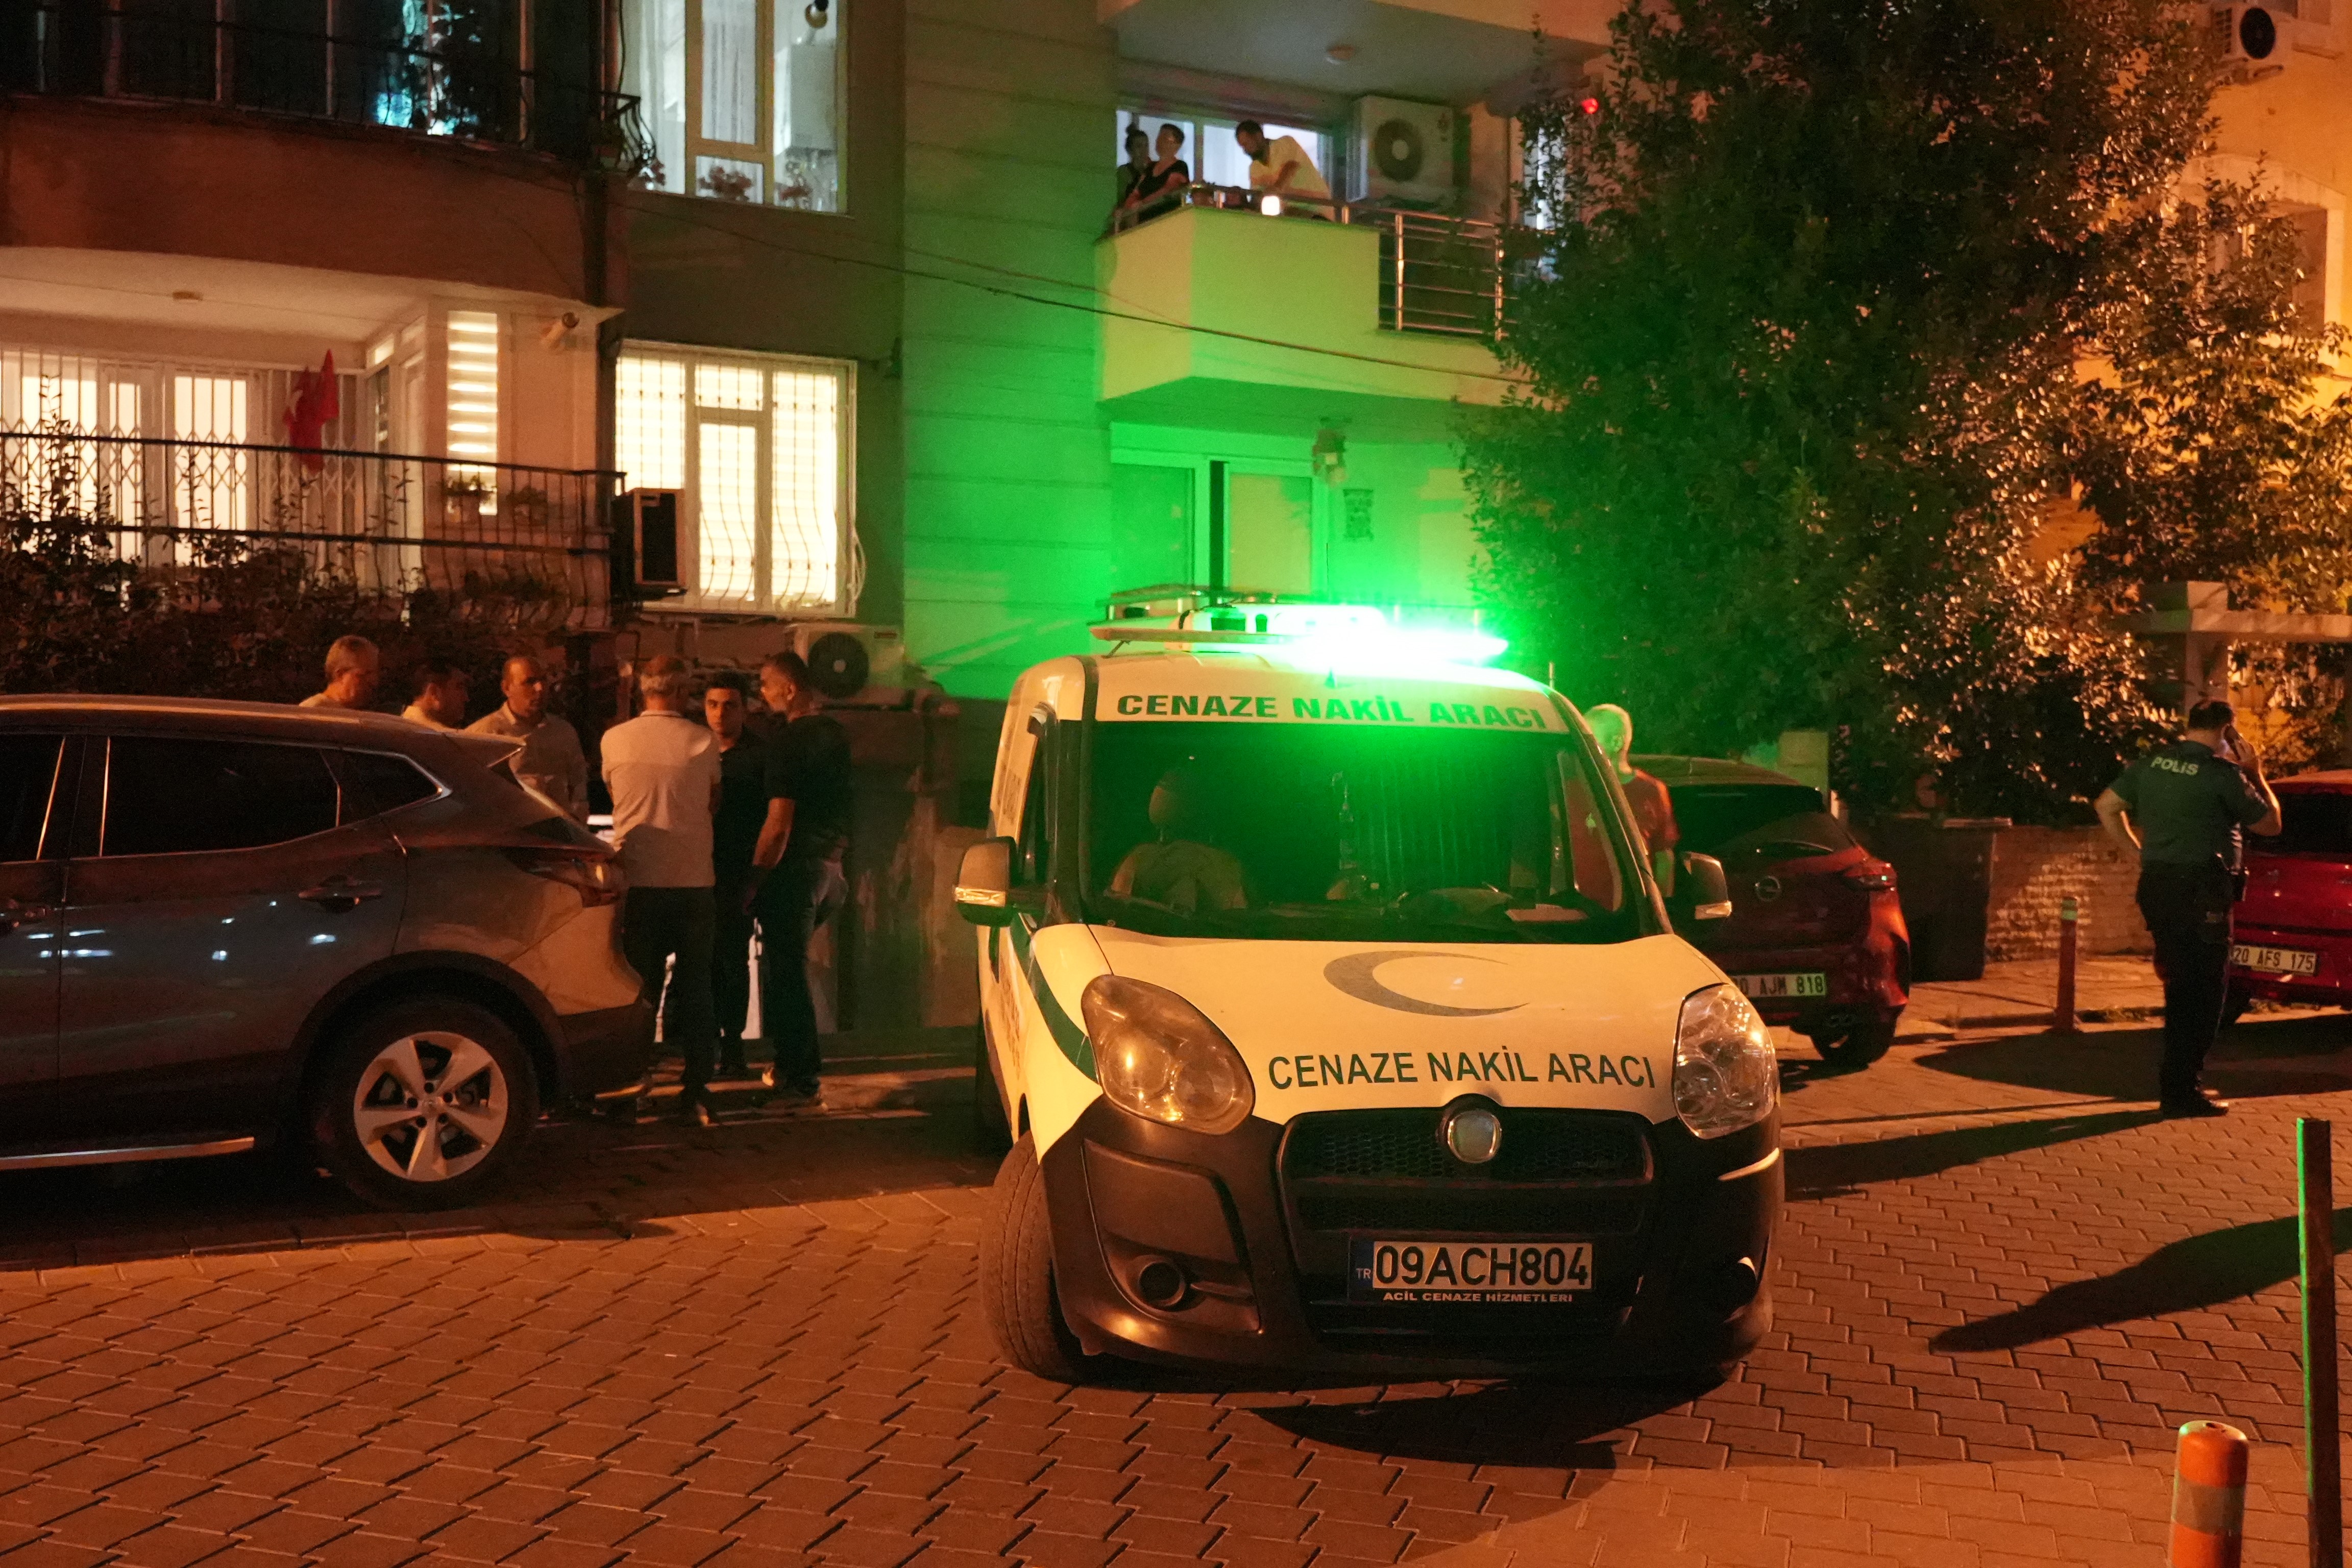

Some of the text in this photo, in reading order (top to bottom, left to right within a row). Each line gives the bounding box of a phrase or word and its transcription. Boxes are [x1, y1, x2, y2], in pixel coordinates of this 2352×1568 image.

[1117, 695, 1547, 730] CENAZE NAKİL ARACI
[2257, 949, 2281, 967] AFS
[2291, 953, 2314, 971] 175
[1796, 975, 1824, 994] 818
[1268, 1045, 1655, 1090] CENAZE NAKİL ARACI
[1356, 1244, 1588, 1286] TR 09ACH804
[1383, 1291, 1418, 1302] ACİL
[1422, 1292, 1482, 1302] CENAZE
